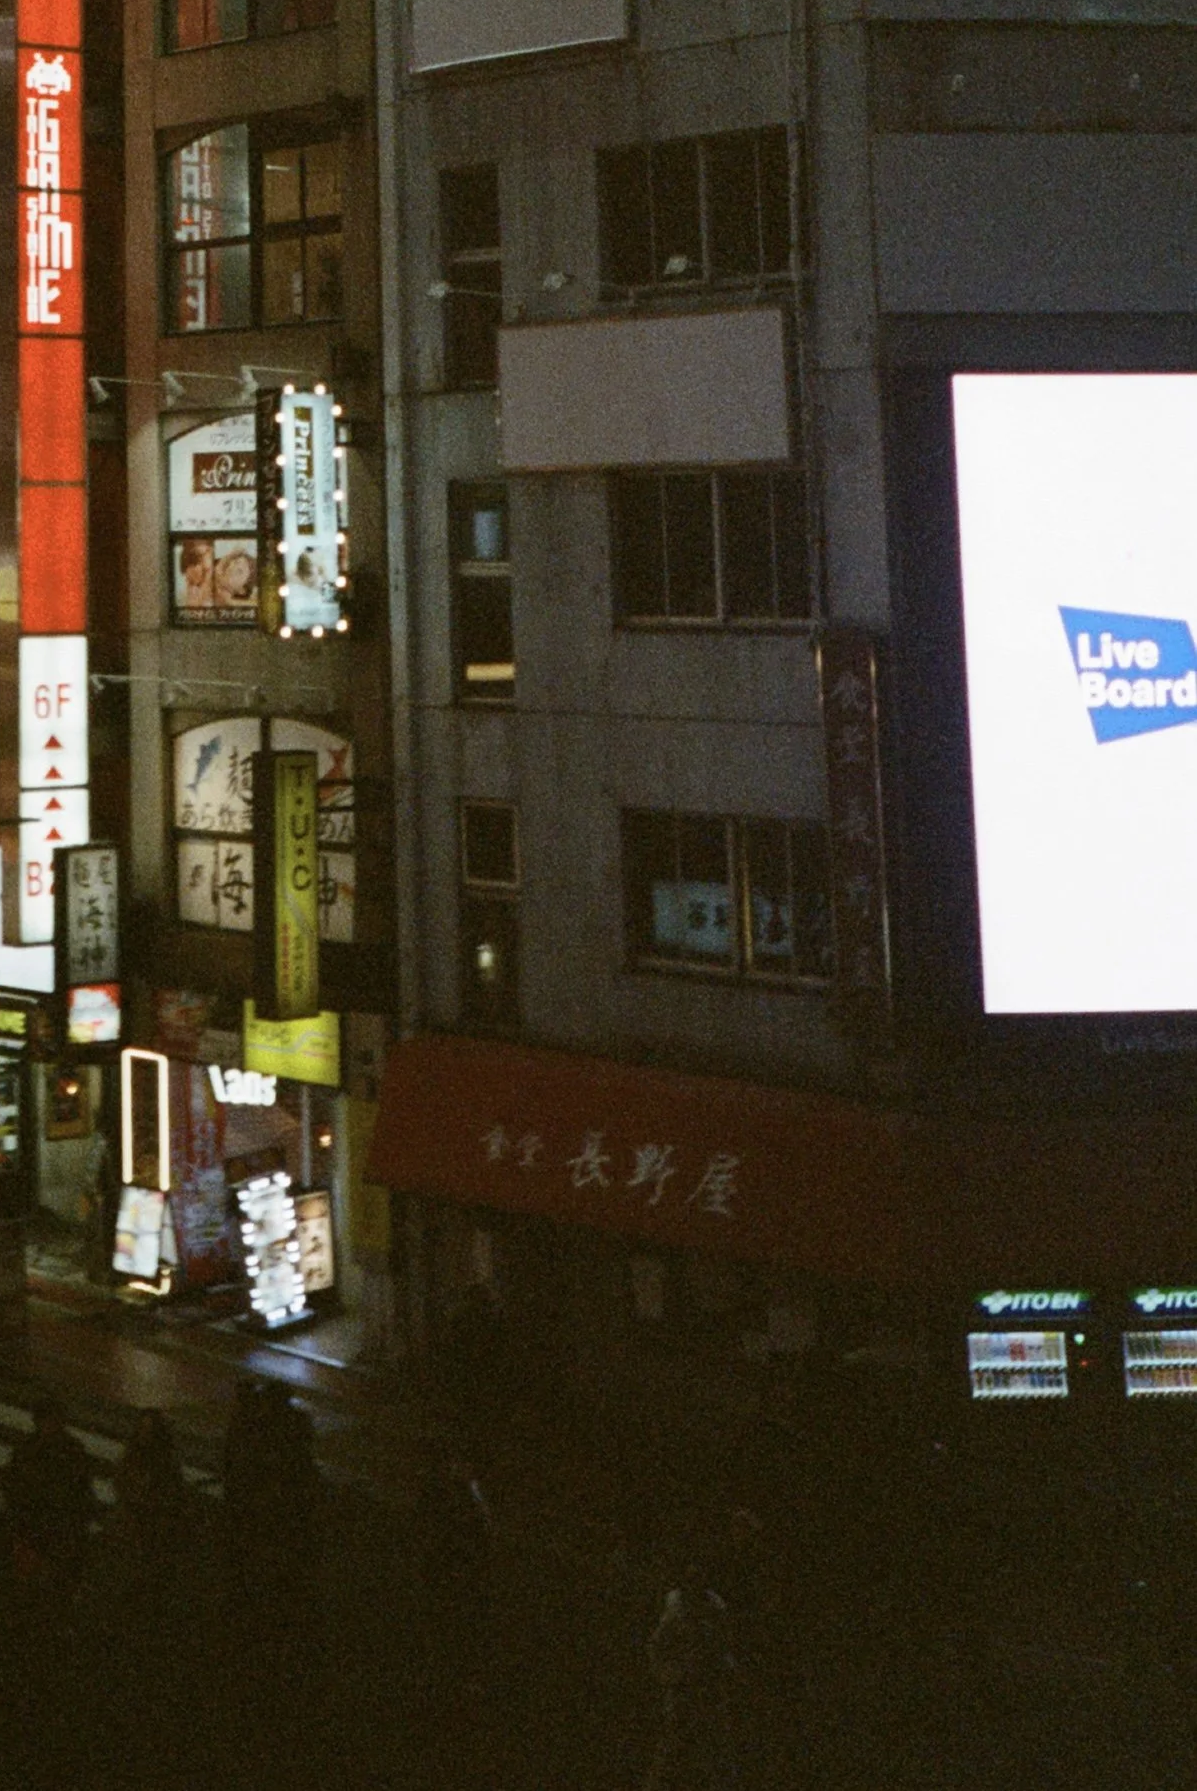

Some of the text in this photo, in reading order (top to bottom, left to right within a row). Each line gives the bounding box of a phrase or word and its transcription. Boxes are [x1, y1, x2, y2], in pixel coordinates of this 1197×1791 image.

[36, 98, 73, 324] GAME
[1077, 632, 1160, 669] Live
[33, 683, 72, 719] 6F
[1081, 670, 1197, 708] Board
[1011, 1291, 1080, 1311] ITO EN
